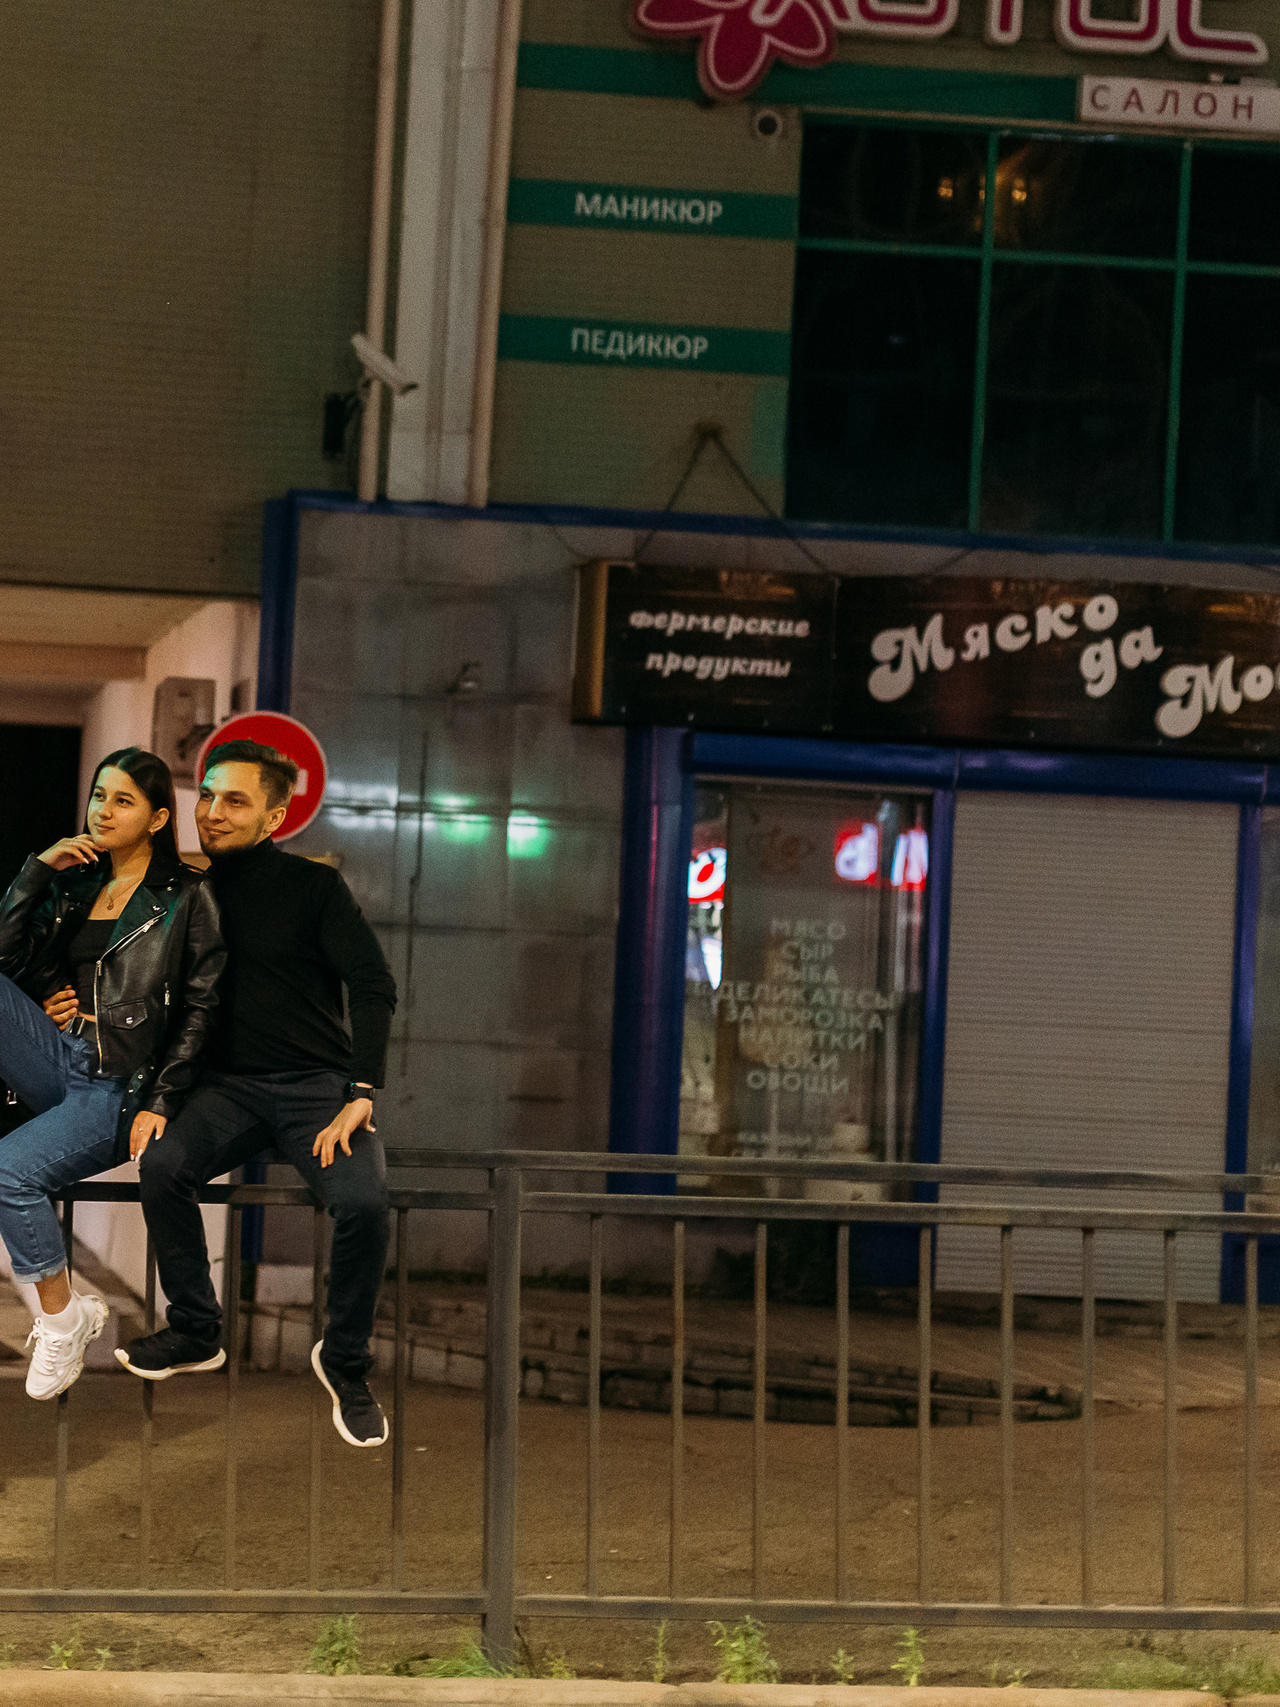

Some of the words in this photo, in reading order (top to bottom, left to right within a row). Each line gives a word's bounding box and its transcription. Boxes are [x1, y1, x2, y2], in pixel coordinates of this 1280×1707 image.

[1088, 84, 1256, 121] САЛОН
[574, 191, 723, 225] МАНИКЮР
[570, 327, 708, 360] ПЕДИКЮР
[645, 651, 791, 681] продукты
[1155, 655, 1280, 738] Мо
